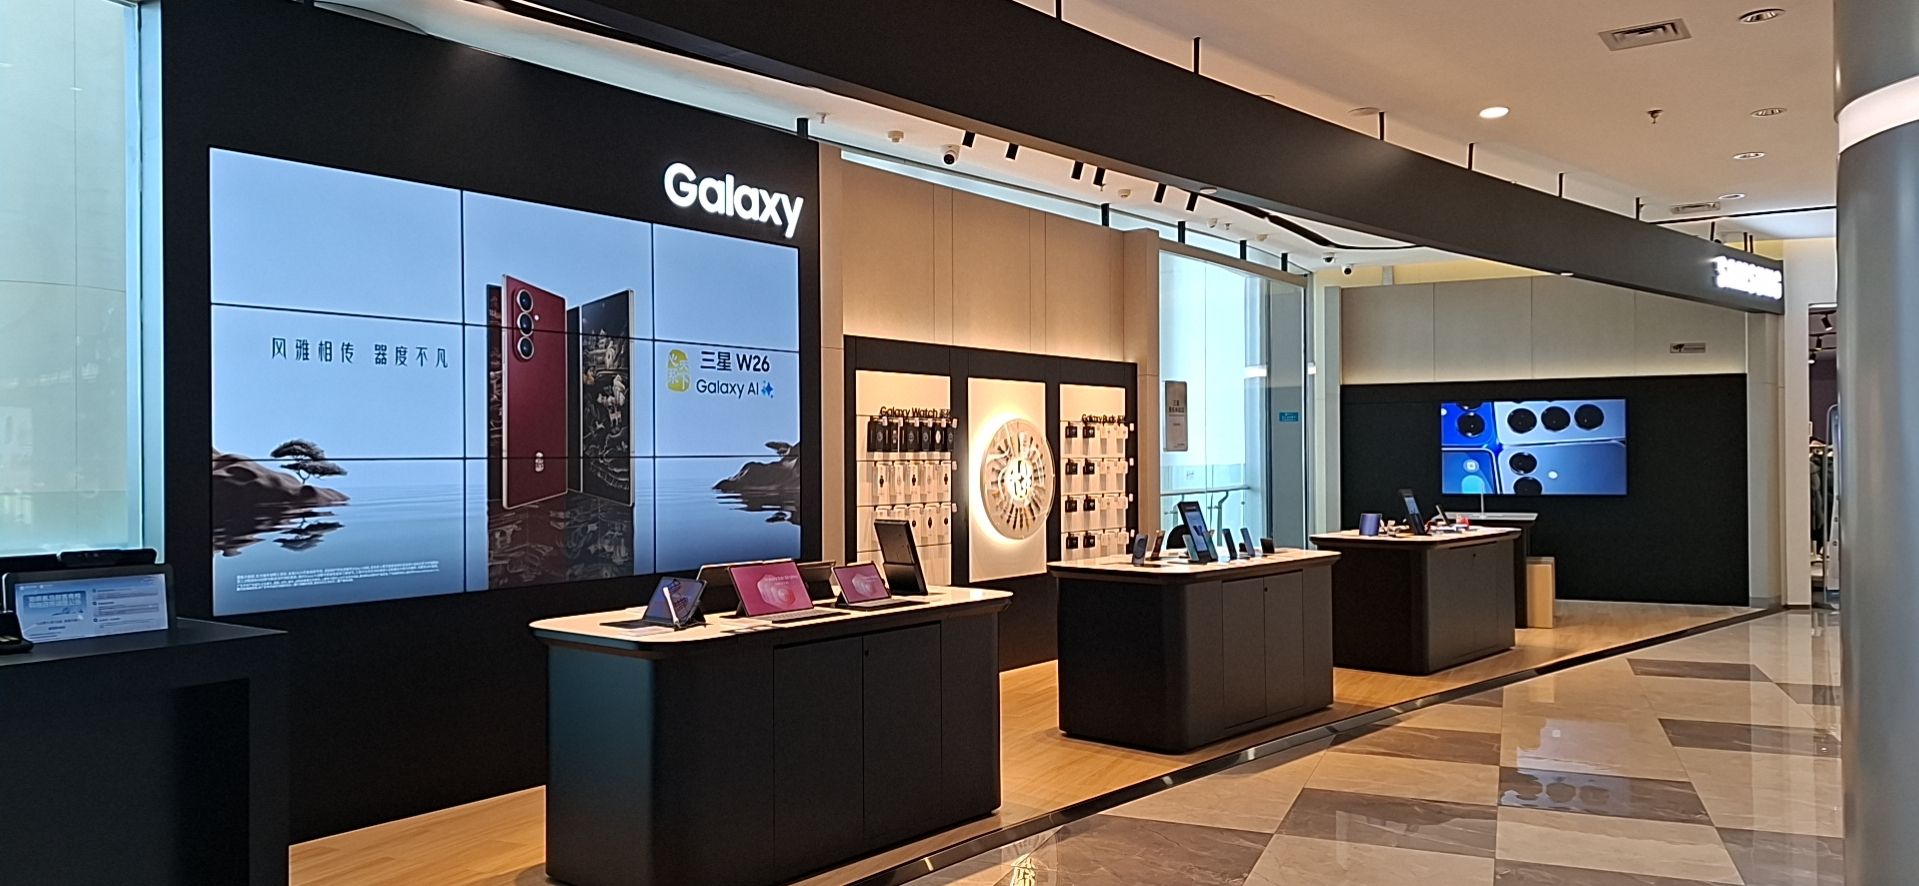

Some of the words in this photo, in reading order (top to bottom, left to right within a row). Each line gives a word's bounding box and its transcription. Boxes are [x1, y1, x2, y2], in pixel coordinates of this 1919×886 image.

[664, 162, 804, 239] Galaxy
[271, 337, 355, 364] 风雅相传
[374, 344, 449, 369] 器度不凡
[700, 351, 733, 372] 三星
[736, 353, 771, 373] W26
[696, 379, 745, 399] Galaxy
[747, 382, 760, 396] AI
[880, 406, 910, 420] Galaxy
[911, 407, 938, 418] Watch
